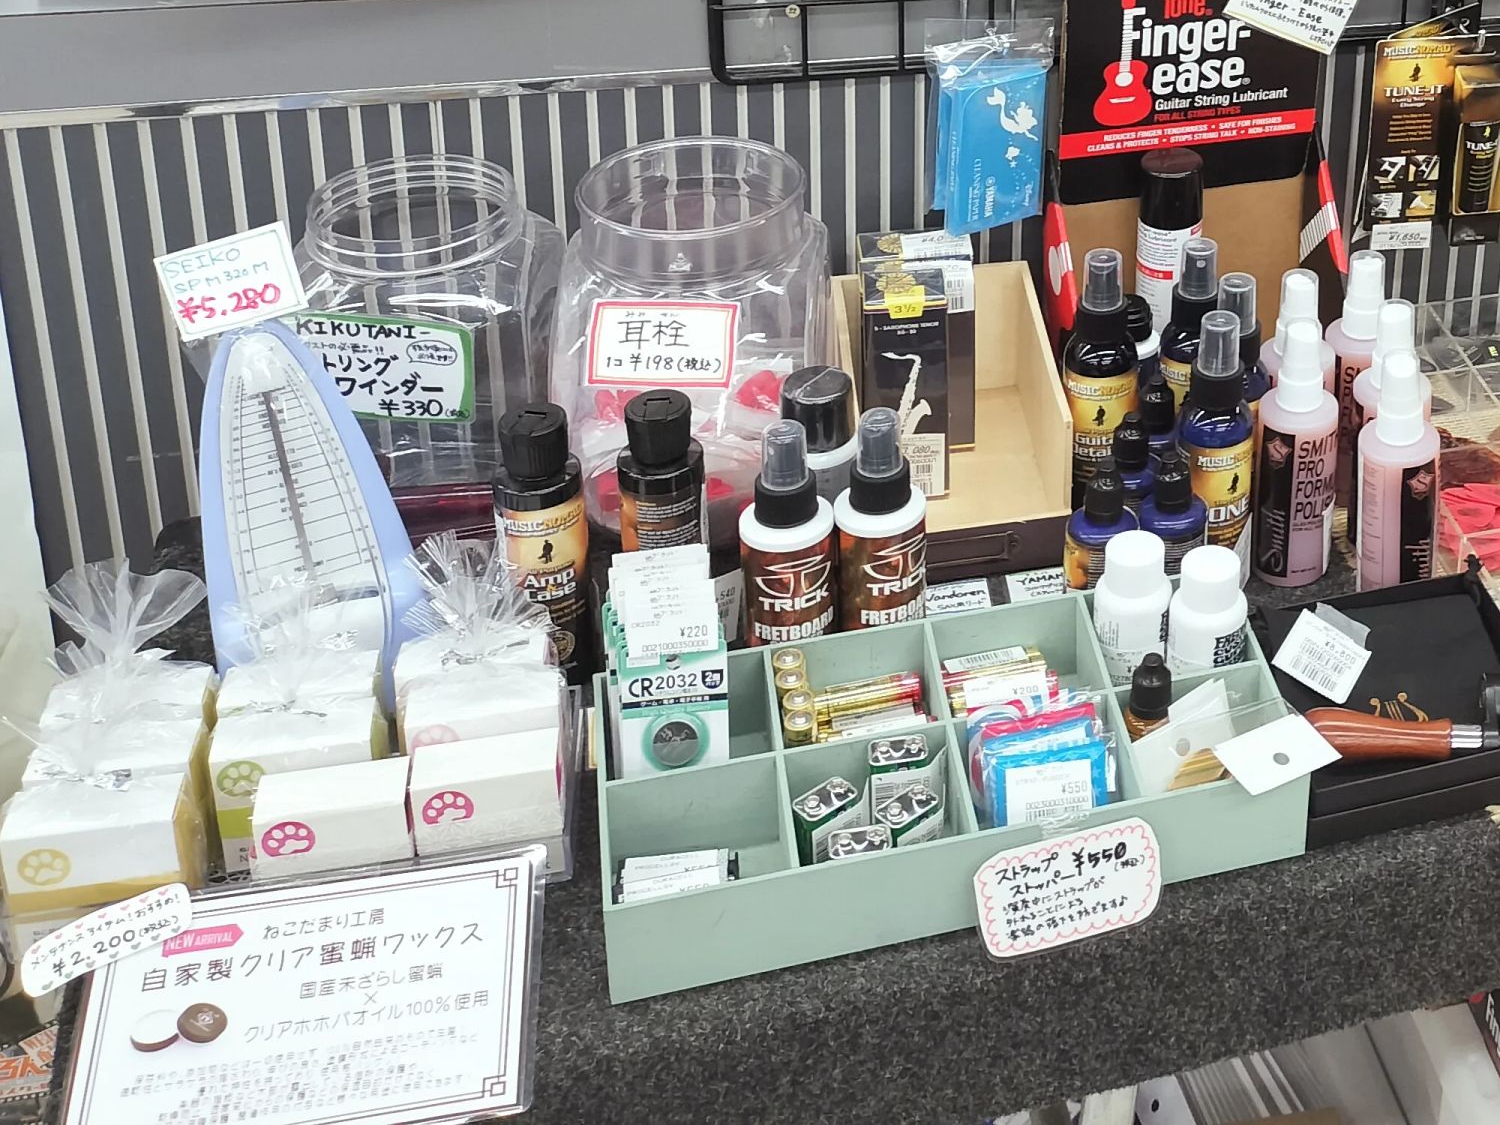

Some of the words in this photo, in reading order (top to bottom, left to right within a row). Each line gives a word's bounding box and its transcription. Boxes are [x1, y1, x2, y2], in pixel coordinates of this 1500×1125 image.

[1151, 57, 1244, 95] ease
[1155, 97, 1191, 110] Guitar
[1194, 93, 1230, 108] String
[1232, 88, 1288, 103] Lubricant
[1384, 84, 1445, 97] TUNE-IT
[161, 247, 241, 278] SEIKO
[617, 318, 690, 350] 耳栓
[335, 372, 444, 396] ワインダー
[1297, 461, 1325, 478] PRO
[523, 568, 575, 590] Amp
[758, 582, 830, 612] TRICK
[680, 625, 708, 638] ¥220
[755, 606, 834, 642] FRETBOARD
[628, 673, 698, 698] CR2032
[1061, 780, 1088, 795] ¥550
[995, 851, 1060, 885] ストラップ
[262, 908, 386, 942] ねこだまり工房
[165, 934, 193, 952] NEW
[195, 930, 234, 947] ARRIVAL
